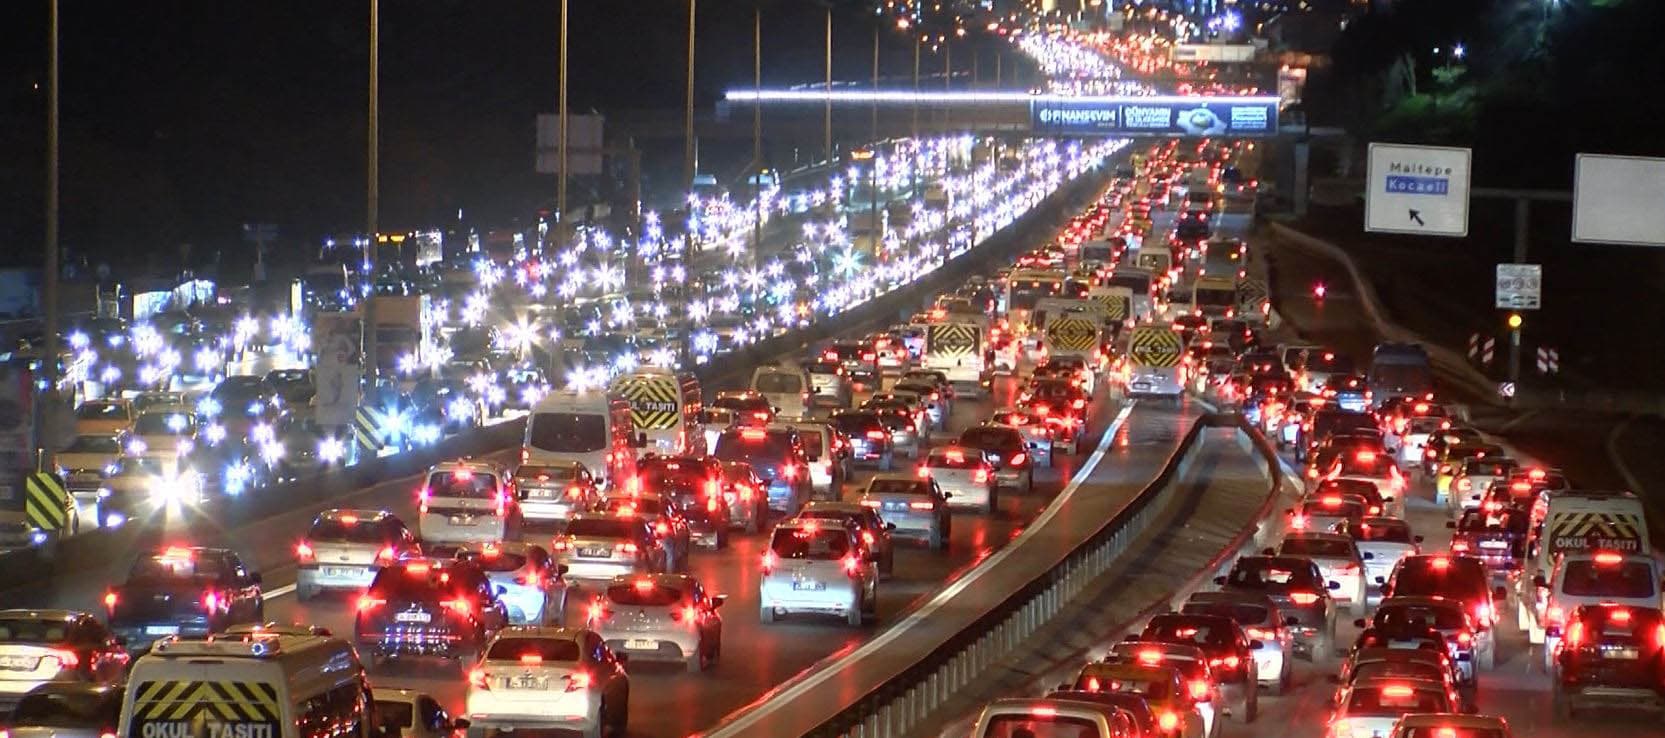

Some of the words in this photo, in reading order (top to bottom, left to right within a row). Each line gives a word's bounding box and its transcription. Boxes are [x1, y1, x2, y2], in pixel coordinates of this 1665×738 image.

[1390, 162, 1452, 176] Maltepe
[1389, 178, 1446, 192] Kocaeli
[1555, 537, 1591, 548] OKUL
[142, 721, 194, 738] OKUL
